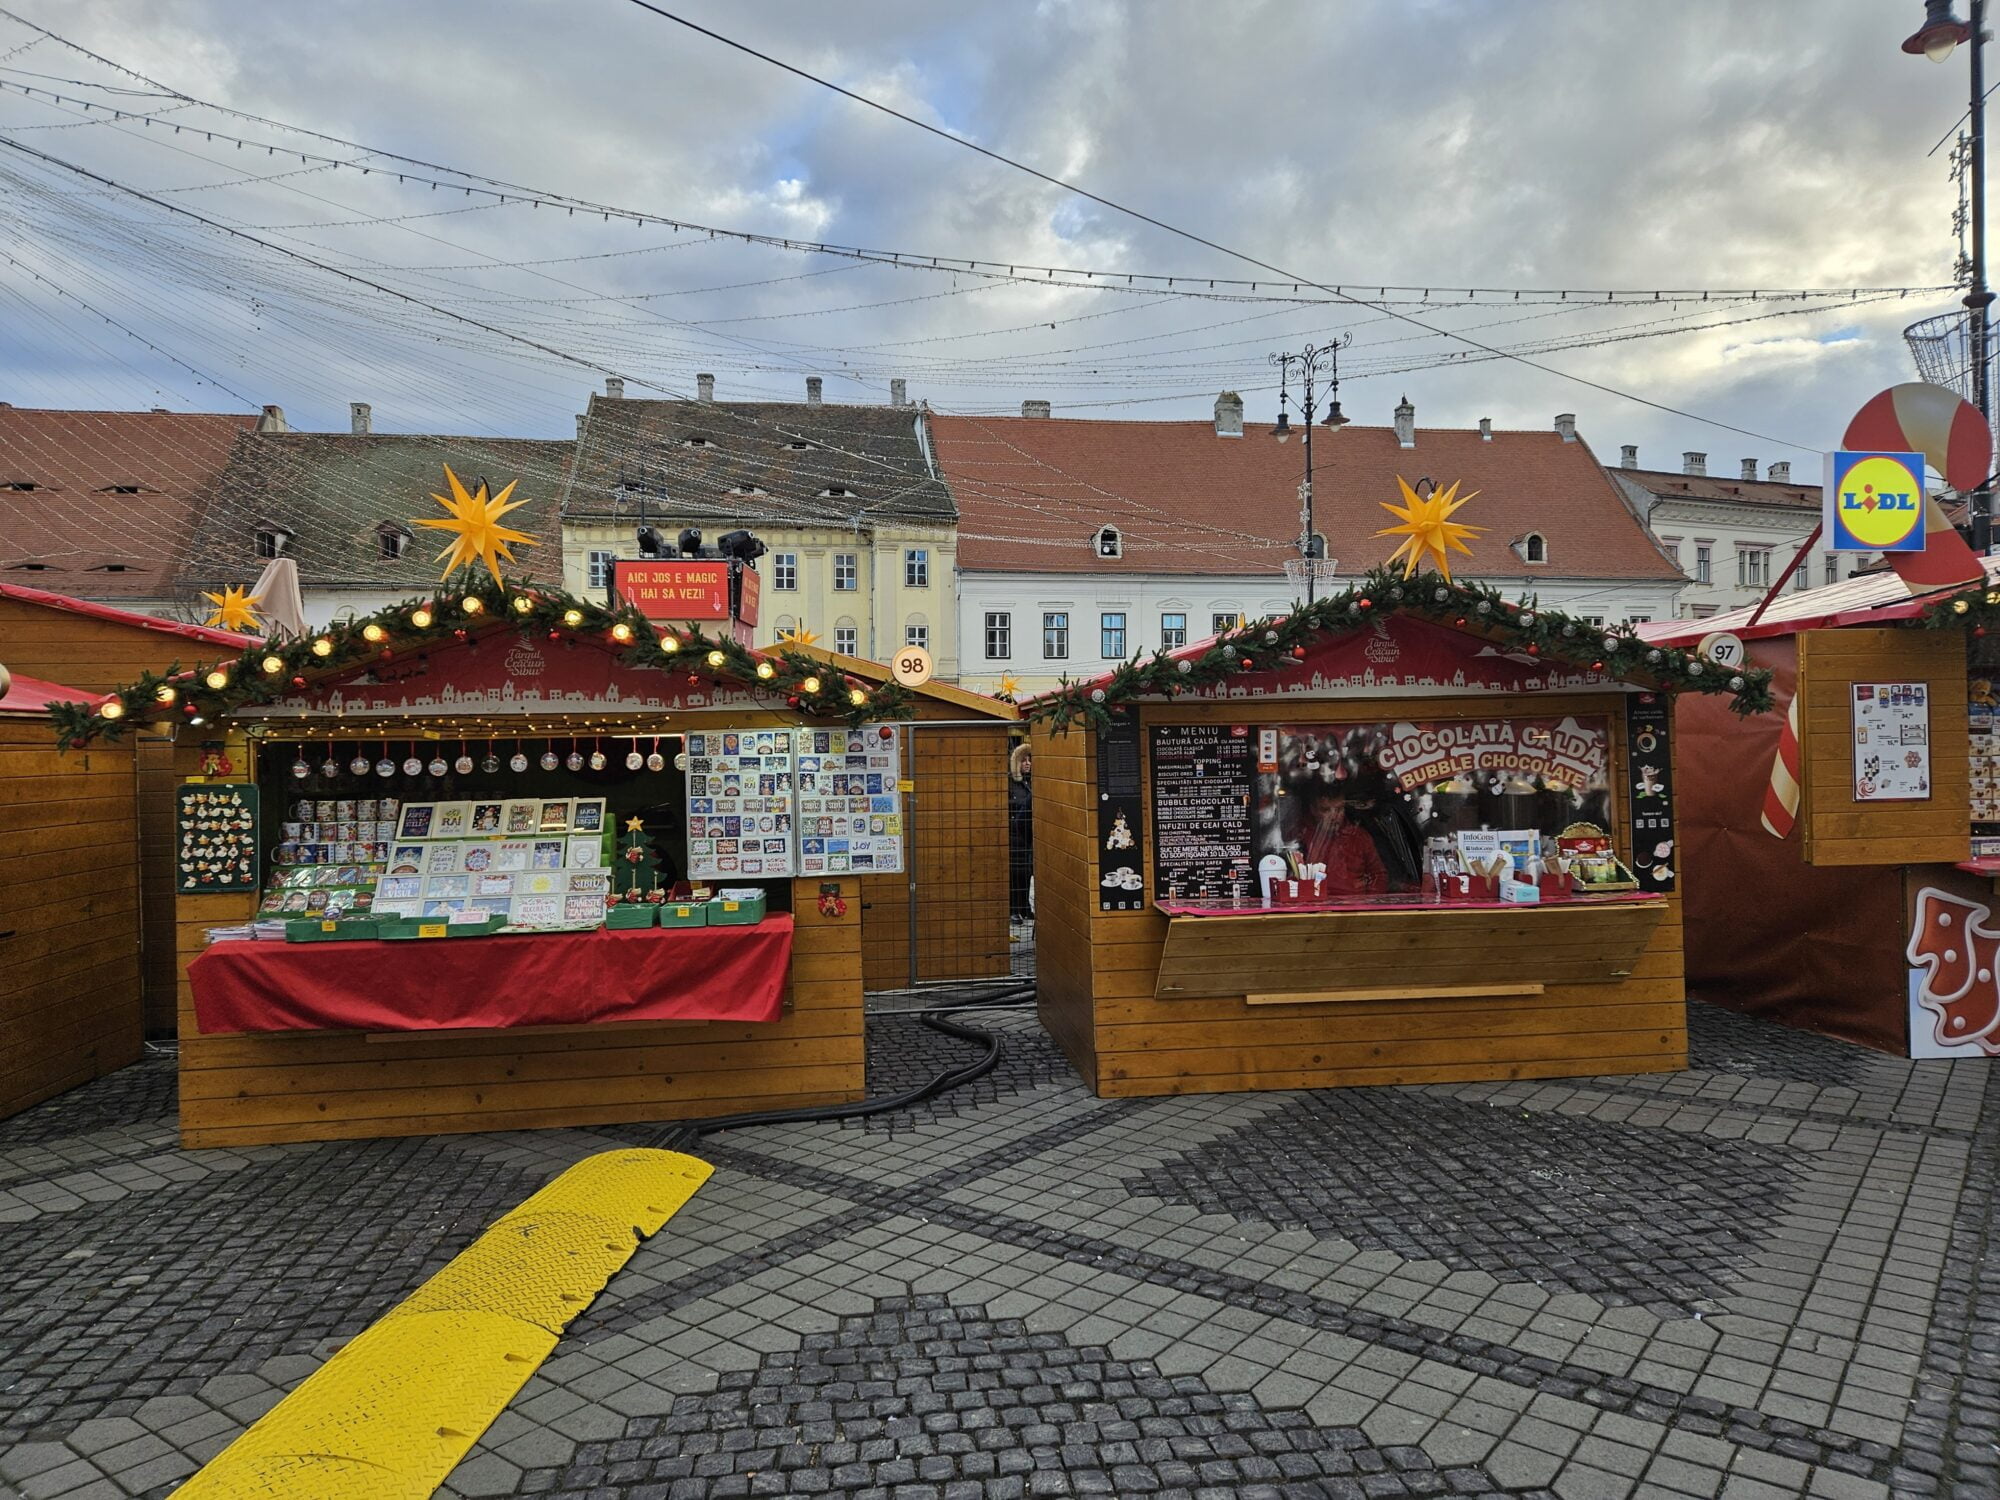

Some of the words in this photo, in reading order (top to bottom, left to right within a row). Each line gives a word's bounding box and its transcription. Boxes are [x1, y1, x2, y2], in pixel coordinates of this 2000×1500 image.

[1844, 484, 1915, 514] LIDL
[628, 572, 648, 583] AICI
[652, 572, 670, 583] JOS
[676, 573, 682, 583] E
[686, 573, 718, 584] MAGIC
[641, 589, 658, 599] HAI
[662, 589, 675, 599] SA
[680, 588, 704, 599] VEZI!
[1715, 646, 1735, 660] 97
[901, 658, 924, 673] 98
[1181, 727, 1218, 735] MENIU
[1194, 736, 1218, 744] CALDĂ
[1379, 720, 1515, 768] CIOCOLATĂ
[1522, 726, 1605, 767] CALDĂ
[1401, 756, 1473, 788] BUBBLE
[1481, 754, 1586, 787] CHOCOLATE
[852, 841, 870, 851] JOY
[574, 879, 600, 888] SIBIU
